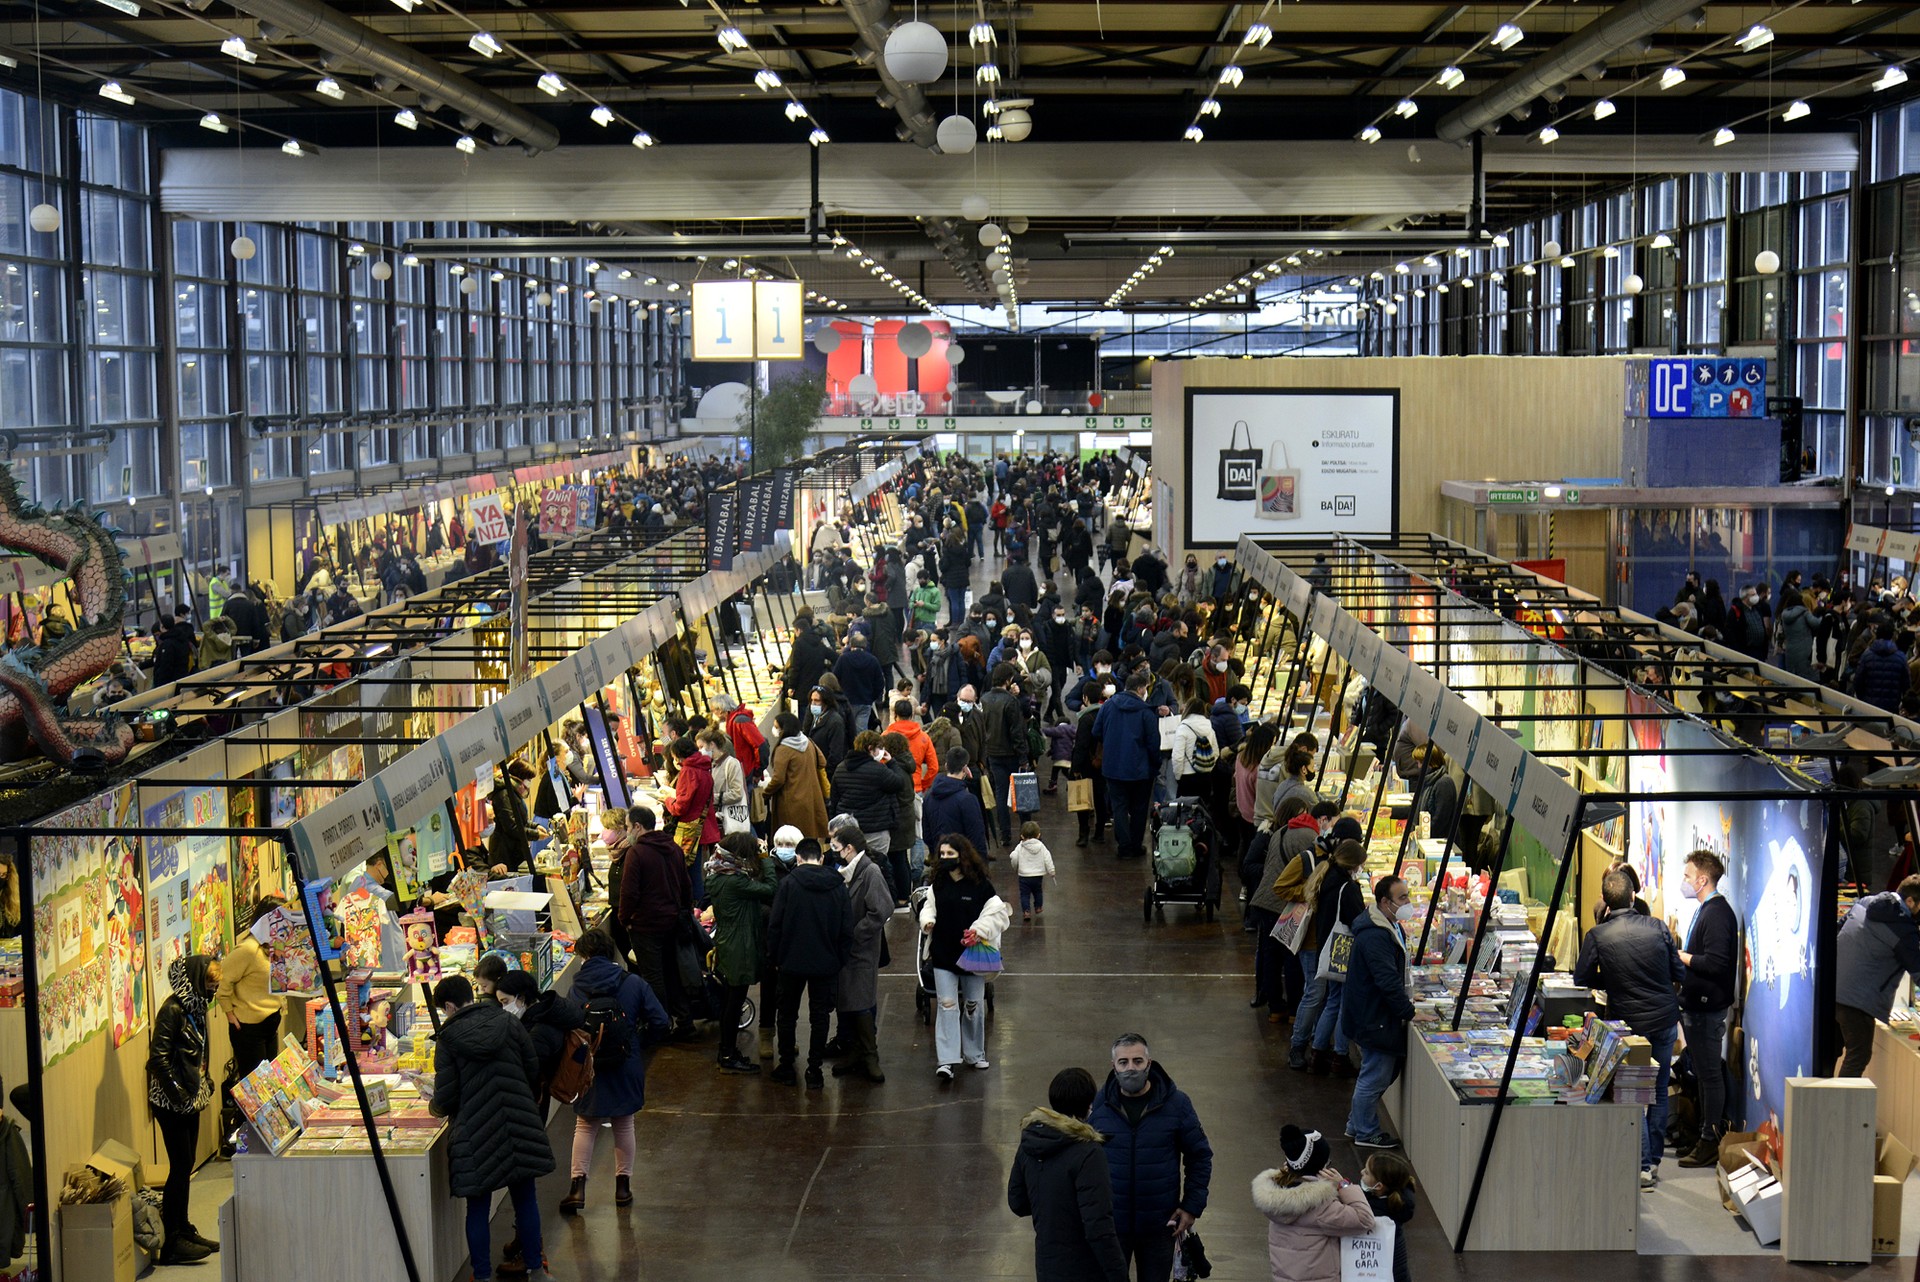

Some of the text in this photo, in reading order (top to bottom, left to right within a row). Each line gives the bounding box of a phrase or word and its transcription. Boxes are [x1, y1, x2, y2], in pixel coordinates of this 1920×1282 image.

[1655, 363, 1687, 412] 02
[1709, 393, 1723, 408] P
[1321, 430, 1359, 439] ESKURATU
[1229, 468, 1251, 482] DA!
[778, 470, 793, 519] IBAIZABAL
[1490, 492, 1522, 500] IRTEERA
[744, 484, 760, 539] IBAIZABAL
[1321, 501, 1353, 510] BA DA!
[474, 504, 502, 523] YA
[477, 521, 507, 542] NIZ
[713, 496, 732, 557] IBAIZABAL
[601, 737, 609, 752] SER
[1352, 1240, 1381, 1250] KANTU
[1361, 1250, 1375, 1259] BAT
[1355, 1260, 1379, 1268] GARA
